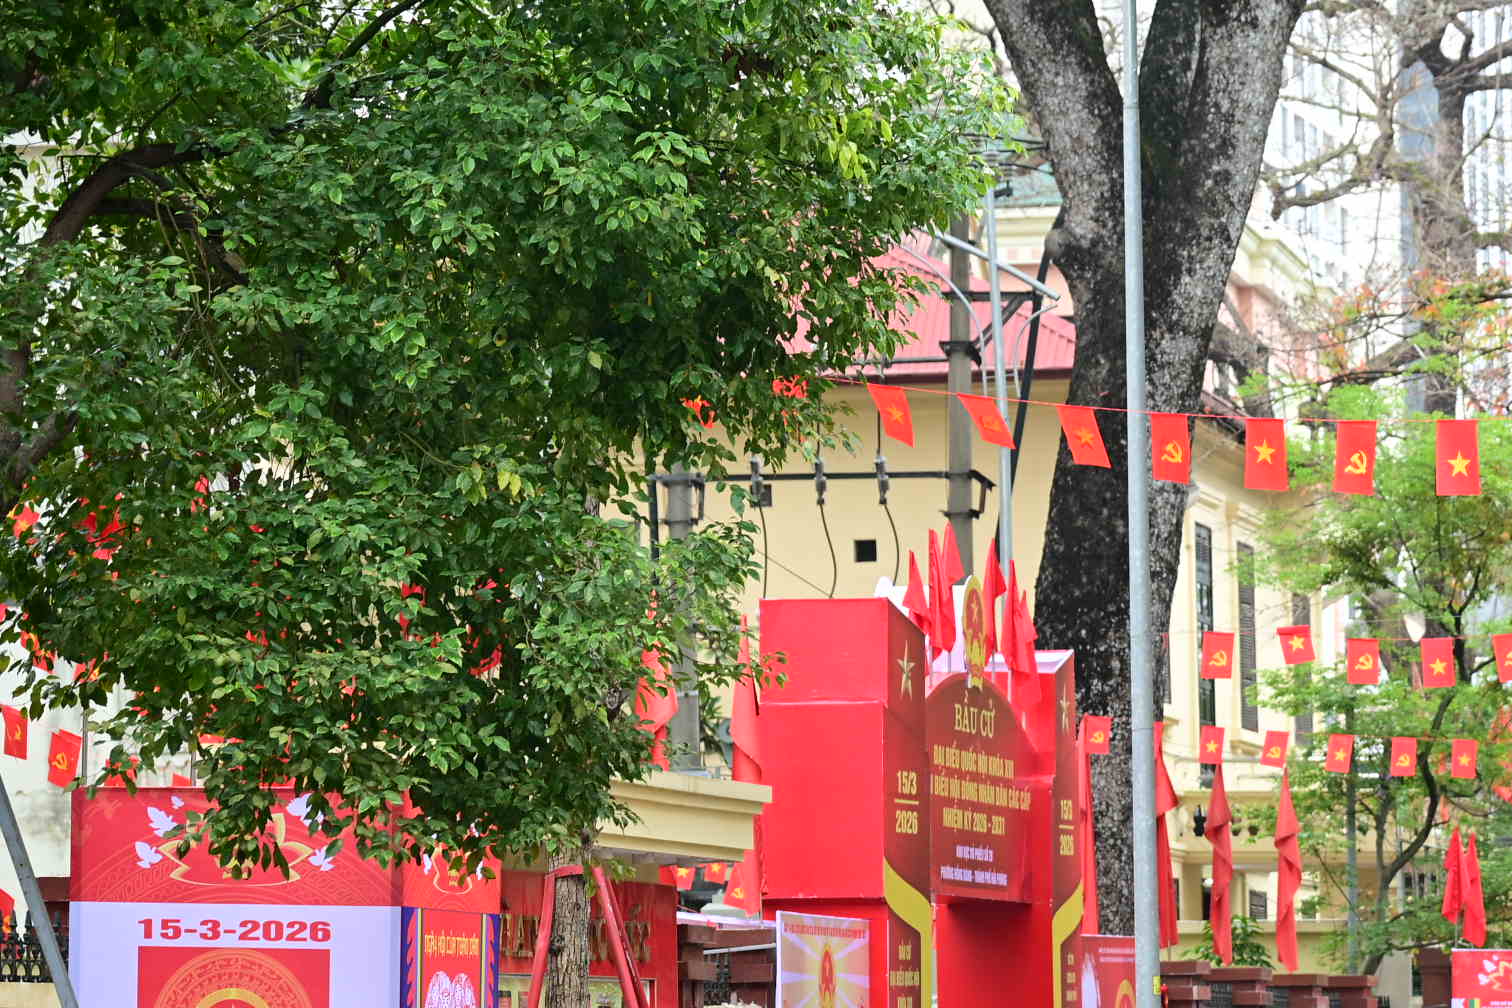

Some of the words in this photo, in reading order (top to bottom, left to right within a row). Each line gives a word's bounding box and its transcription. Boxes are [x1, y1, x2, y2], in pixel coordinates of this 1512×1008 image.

[954, 691, 978, 734] BẦU
[980, 698, 996, 738] CỬ
[896, 770, 918, 796] 15/3
[896, 810, 918, 834] 2026
[138, 918, 331, 942] 15-3-2026
